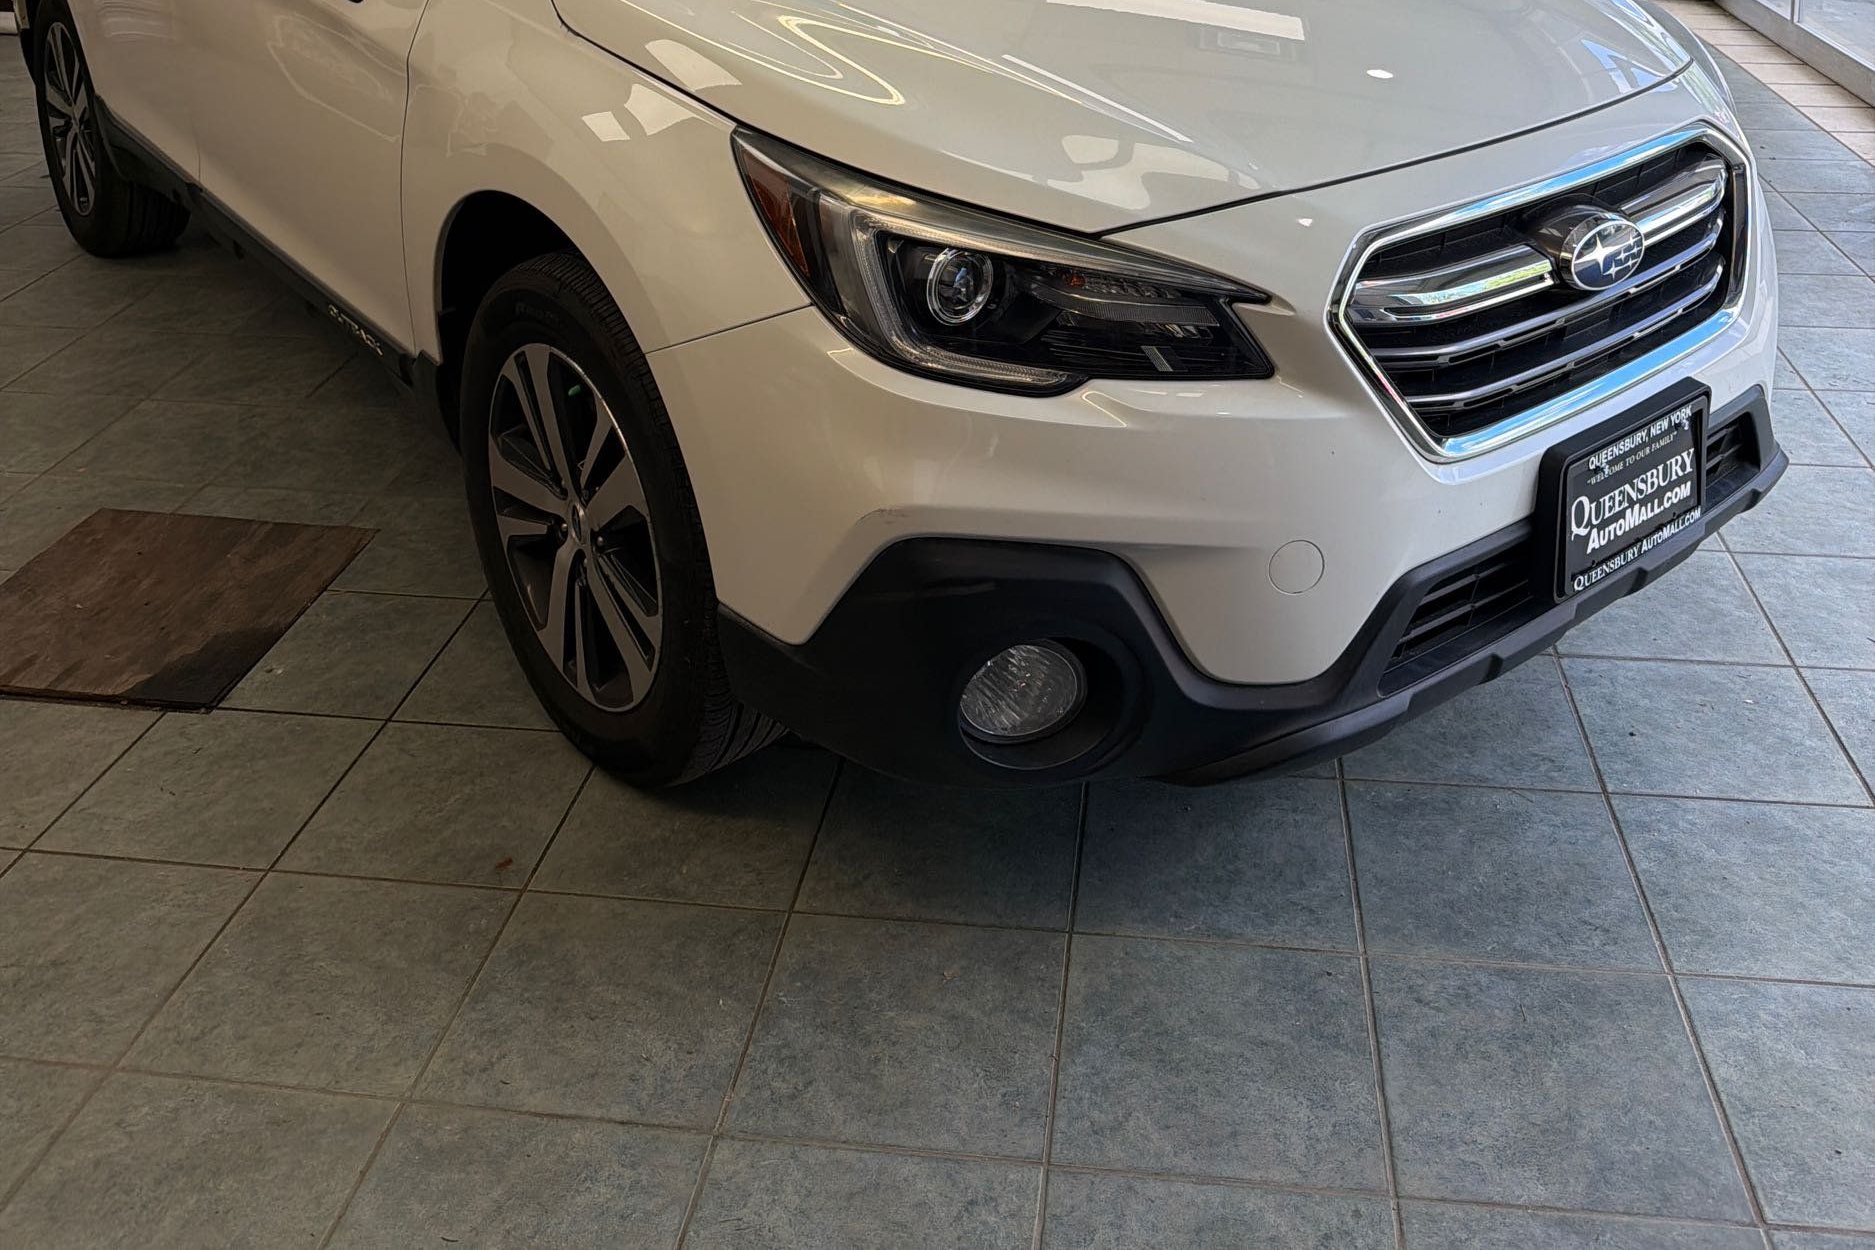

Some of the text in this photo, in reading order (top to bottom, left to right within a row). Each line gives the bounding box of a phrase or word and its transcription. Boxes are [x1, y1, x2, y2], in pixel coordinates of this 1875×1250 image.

[1588, 405, 1692, 470] QUEENSBURY, NEW YORK
[1626, 455, 1635, 467] TO
[1636, 446, 1651, 460] OUR
[1571, 447, 1695, 541] QUEENSBURY
[1574, 543, 1640, 591] QUEENSBURY
